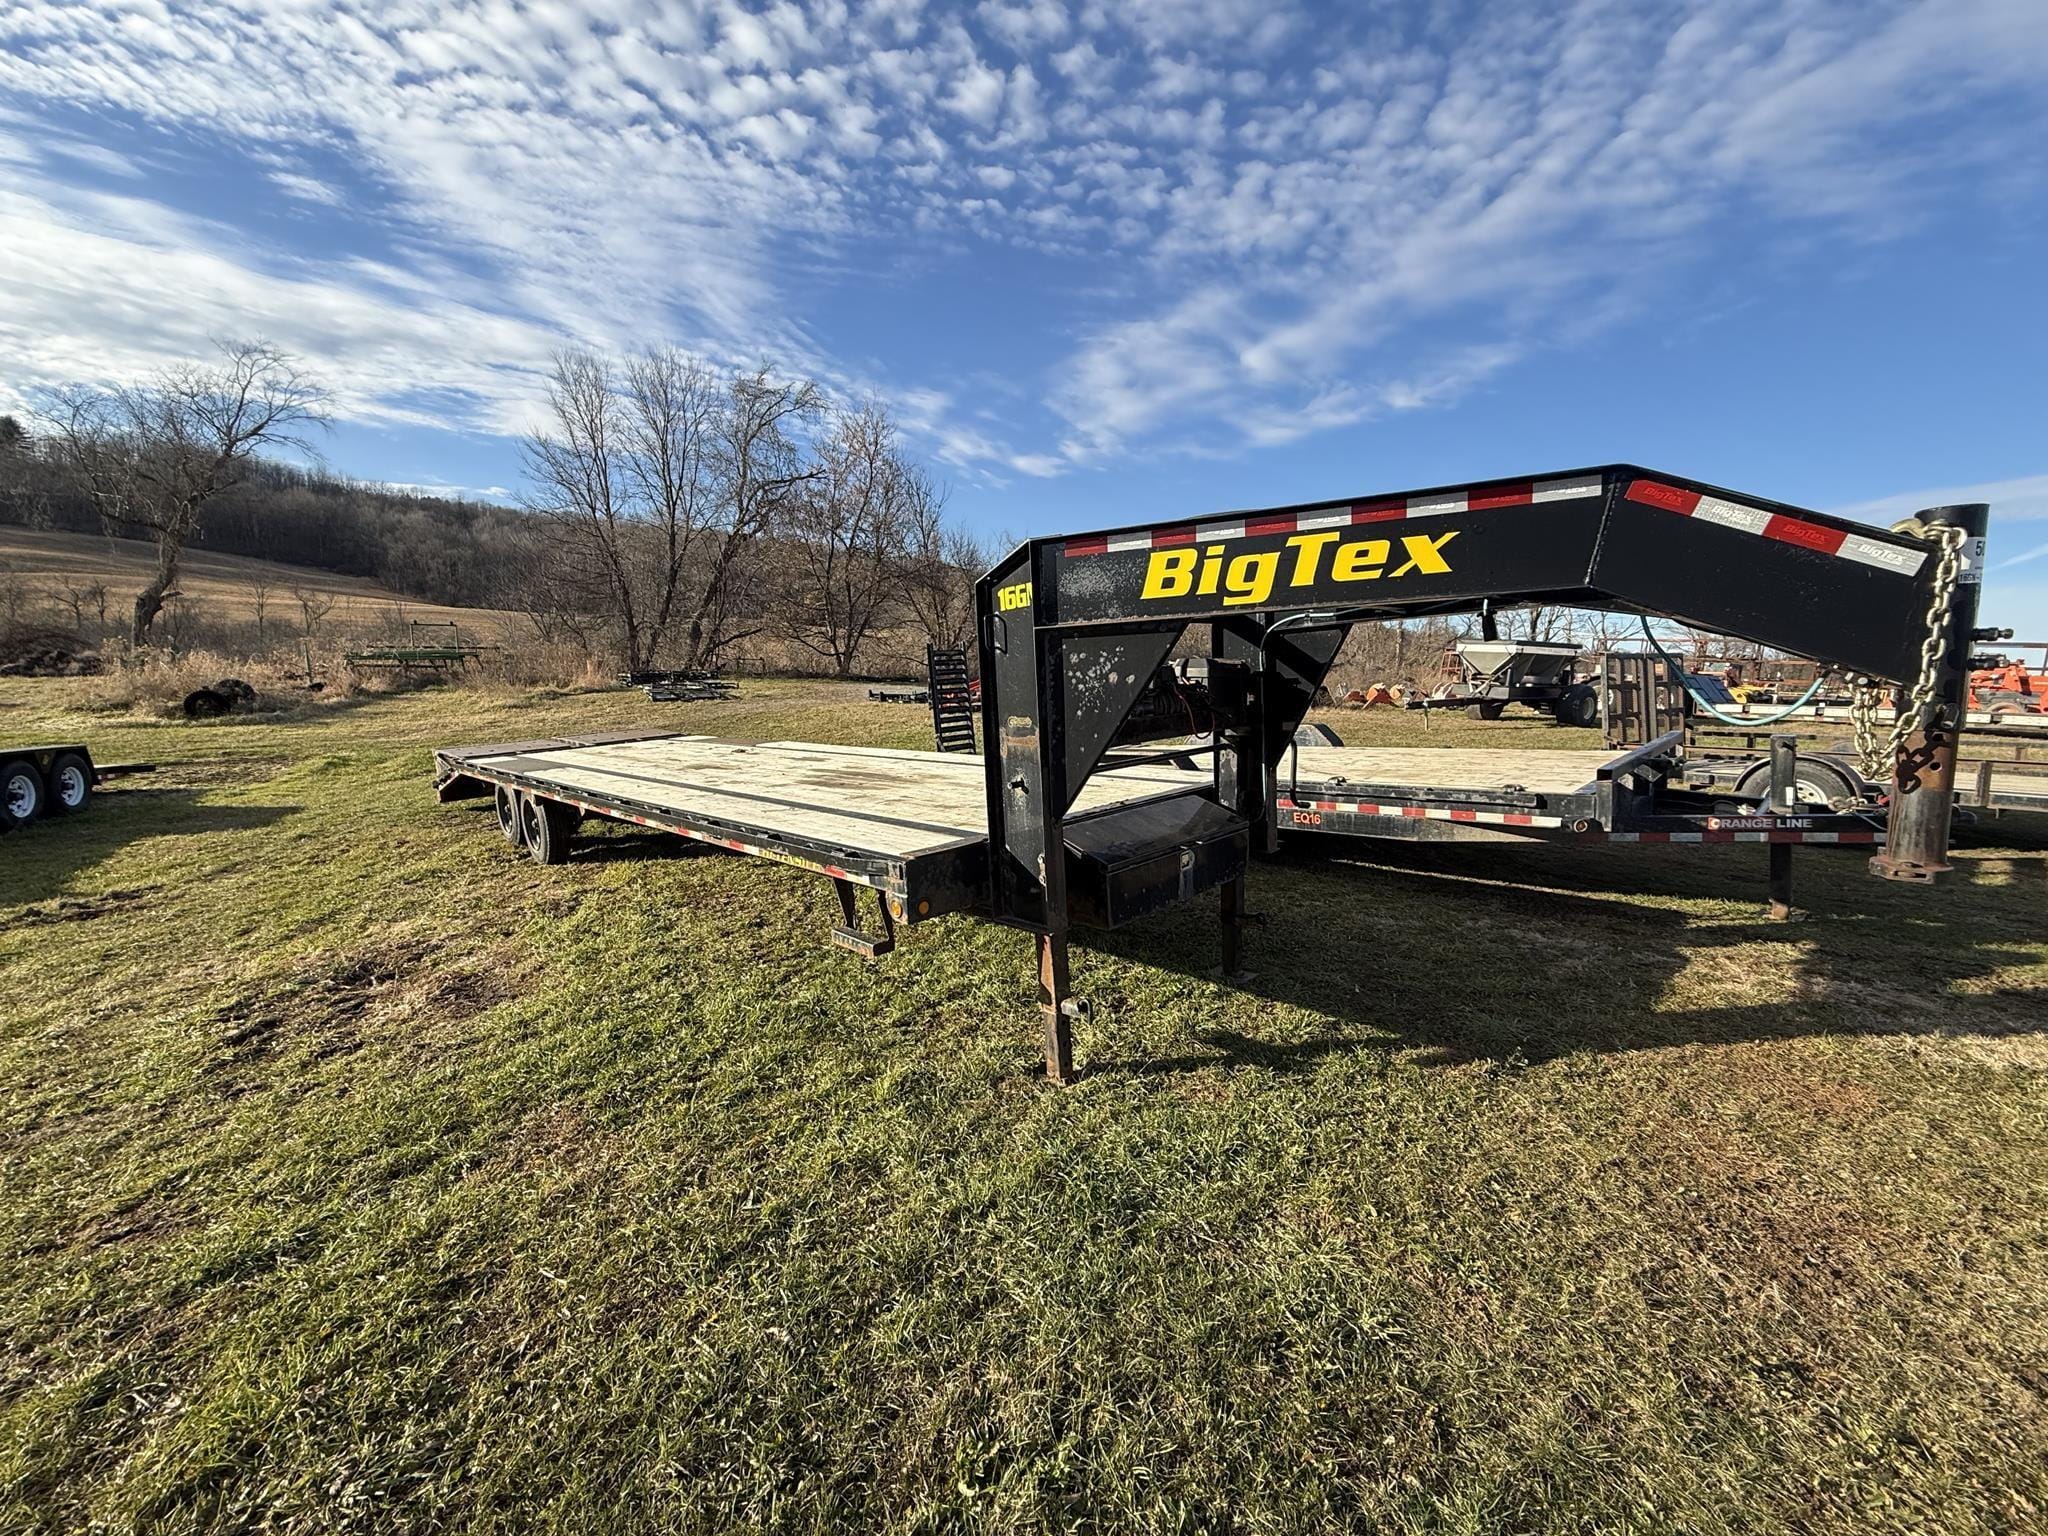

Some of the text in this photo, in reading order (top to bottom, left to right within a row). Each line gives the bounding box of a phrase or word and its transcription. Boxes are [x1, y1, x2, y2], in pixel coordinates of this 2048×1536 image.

[1643, 487, 1684, 504] BigTex
[1711, 505, 1753, 522] BigTex
[1784, 524, 1829, 542] BigTex
[1858, 544, 1908, 564] BigTex
[1140, 531, 1461, 606] BigTex
[1293, 812, 1321, 825] EQ16
[1776, 818, 1813, 828] LINE
